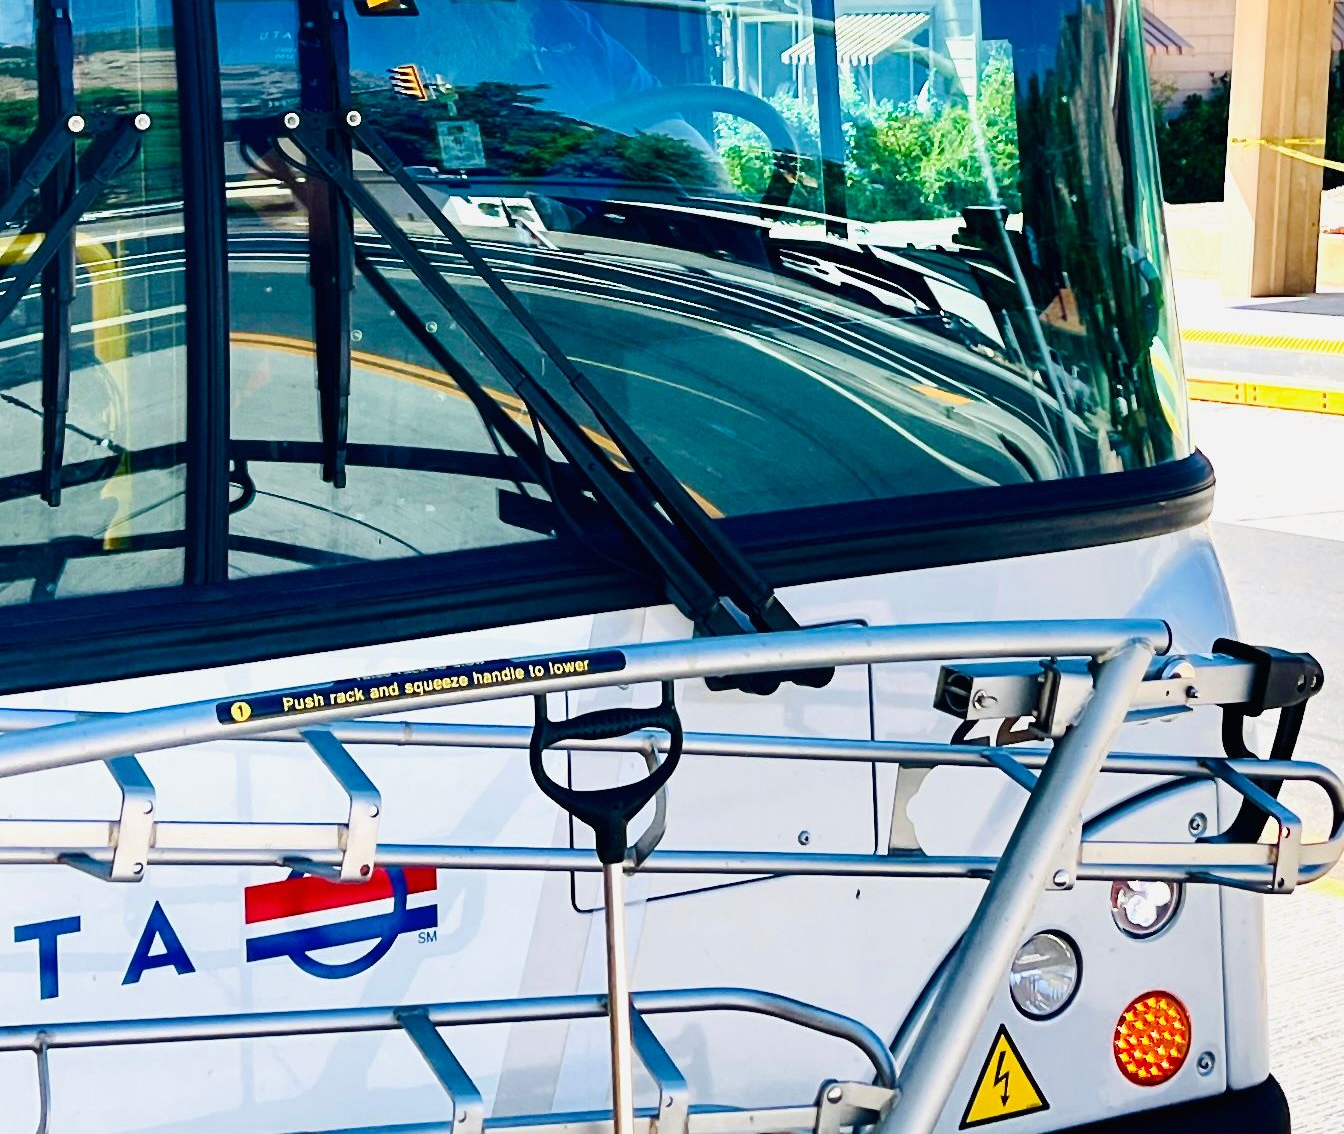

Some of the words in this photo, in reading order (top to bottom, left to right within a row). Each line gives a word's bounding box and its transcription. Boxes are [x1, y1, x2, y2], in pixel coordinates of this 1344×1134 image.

[283, 693, 325, 712] Push
[330, 687, 364, 705] rack
[370, 682, 399, 700] and
[404, 673, 468, 695] squeeze
[473, 666, 525, 684] handle
[529, 664, 544, 678] to
[549, 658, 590, 675] lower
[418, 930, 437, 944] SM
